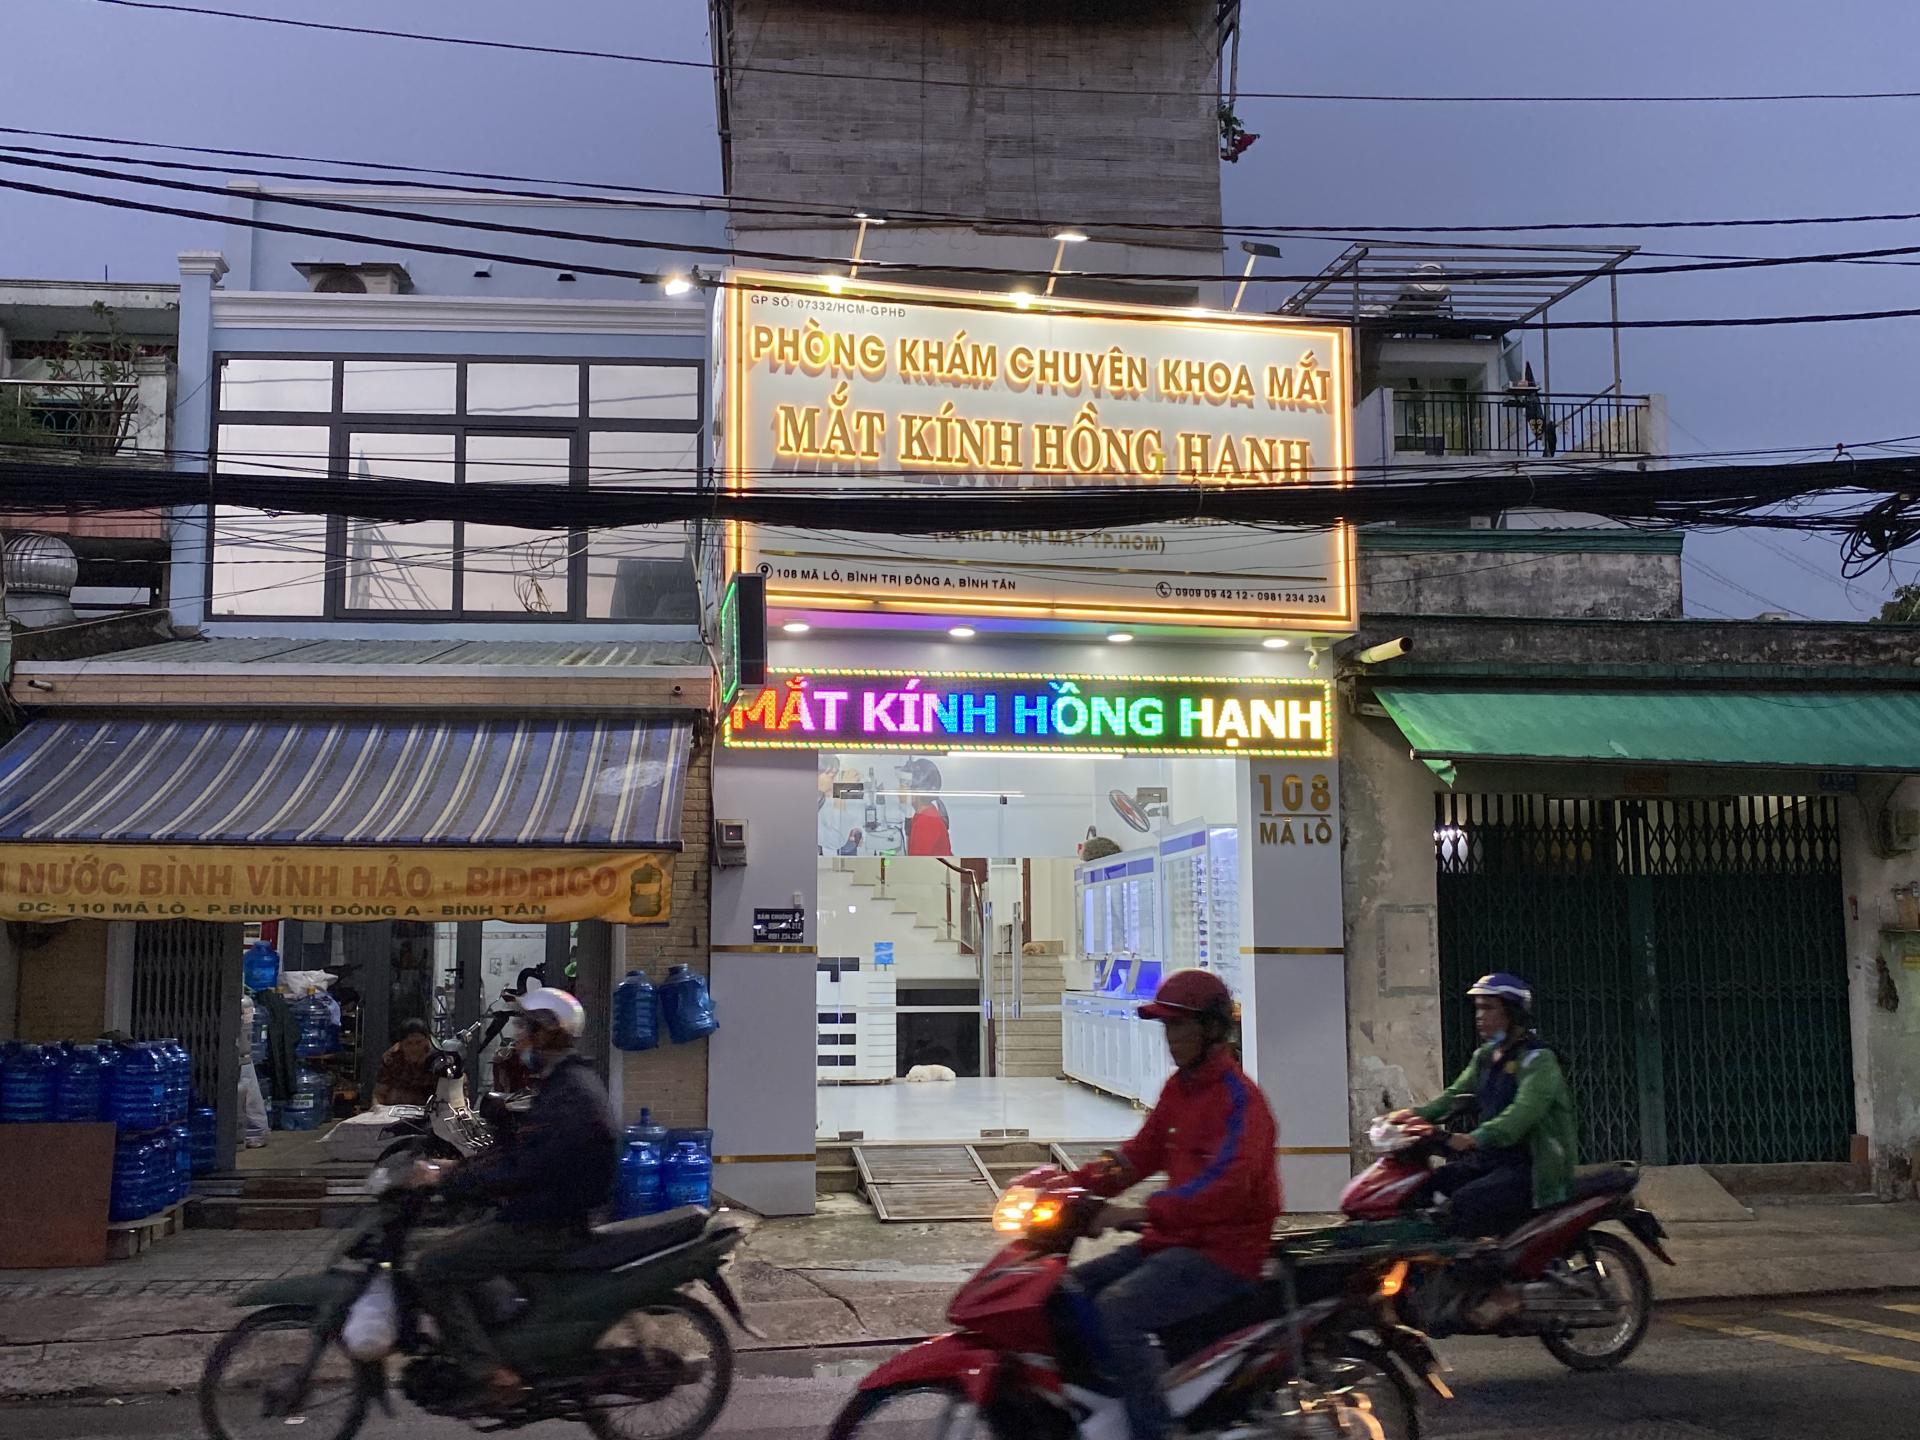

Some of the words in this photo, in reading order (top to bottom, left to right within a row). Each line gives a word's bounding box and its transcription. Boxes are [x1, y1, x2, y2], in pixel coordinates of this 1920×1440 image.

[750, 294, 768, 305] GP
[797, 298, 906, 318] 07332/HCM-GPHĐ
[753, 317, 886, 369] PHÒNG
[899, 329, 998, 379] KHÁM
[1009, 345, 1148, 390] CHUYÊN
[1163, 358, 1255, 397] KHOA
[1268, 350, 1331, 402] MẮT
[778, 381, 885, 458] MẮT
[899, 401, 1024, 469] KÍNH
[1034, 401, 1166, 475] HỒNG
[776, 568, 798, 579] 108
[847, 570, 878, 583] BÌNH
[904, 573, 940, 586] ĐÔNG
[943, 577, 956, 588] A,
[959, 576, 988, 589] BÌNH
[1175, 587, 1201, 597] 0909
[1204, 588, 1217, 598] 09
[1220, 589, 1233, 599] 42
[1236, 590, 1248, 600] 12
[1257, 591, 1282, 601] 0981
[1286, 593, 1304, 602] 234
[1307, 594, 1326, 603] 234
[732, 676, 848, 731] MẮT
[863, 678, 997, 734] KÍNH
[1014, 680, 1165, 737] HỒNG
[1179, 696, 1323, 748] HẠNH
[1258, 774, 1331, 811] 108
[1259, 816, 1296, 844] MÃ
[1303, 816, 1332, 844] LÒ
[20, 854, 128, 896] NƯỚC
[139, 855, 233, 896] BÌNH
[247, 856, 339, 897] VĨNH
[351, 854, 432, 898] HẢO
[466, 866, 618, 898] BIDRICO
[17, 902, 57, 914] ĐC:
[67, 902, 105, 914] 110
[112, 901, 149, 914] MÃ
[157, 901, 187, 915] LÒ
[207, 902, 282, 916] P.BÌNH
[289, 904, 323, 917] TRỊ
[331, 902, 398, 916] ĐÔNG
[404, 905, 420, 916] A
[441, 902, 494, 916] BÌNH
[501, 902, 547, 916] TÂN
